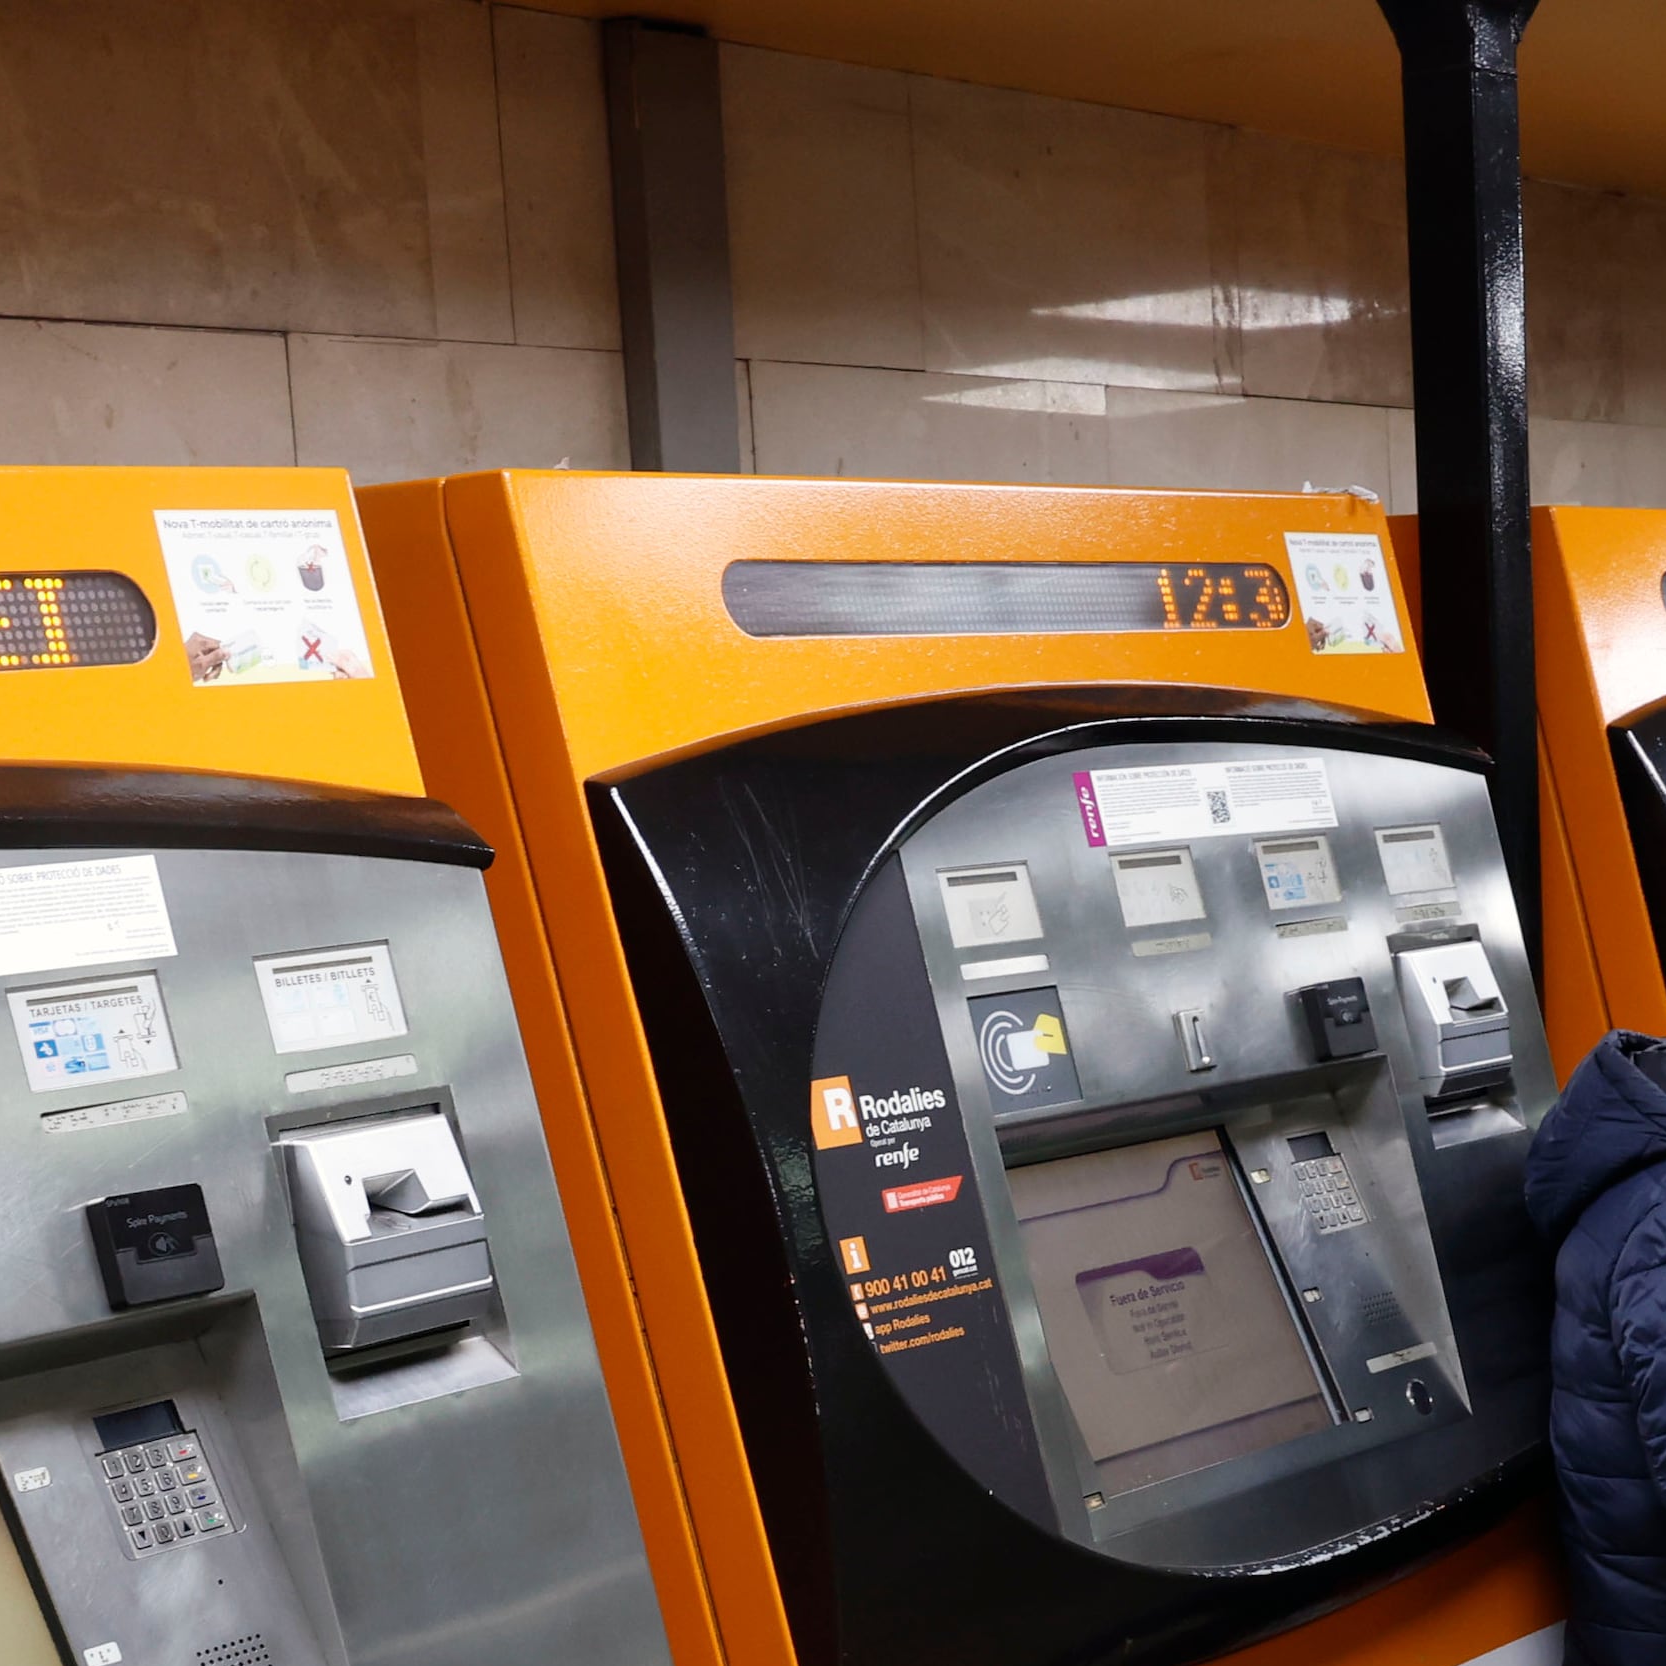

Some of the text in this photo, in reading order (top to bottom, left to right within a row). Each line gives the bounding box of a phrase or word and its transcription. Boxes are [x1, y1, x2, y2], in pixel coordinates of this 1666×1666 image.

[163, 518, 189, 529] Nova
[190, 518, 245, 529] T-mobilitat
[247, 519, 258, 529] de
[260, 517, 290, 529] cartró
[1080, 786, 1100, 838] renfe
[7, 872, 34, 885] SOBRE
[36, 867, 81, 881] PROTECCIÓ
[82, 866, 94, 877] DE
[95, 864, 123, 876] DADES
[274, 972, 323, 988] BILLETES
[330, 966, 376, 981] BITLLETS
[29, 1003, 82, 1018] TARJETAS
[90, 994, 144, 1010] TARGETES
[823, 1087, 858, 1131] R
[859, 1086, 946, 1120] Rodalies
[865, 1115, 933, 1138] de Catalunya
[874, 1141, 920, 1170] renfe
[948, 1246, 976, 1268] 012
[864, 1278, 891, 1298] 900
[892, 1273, 909, 1291] 41
[911, 1269, 929, 1288] 00
[930, 1265, 947, 1283] 41
[1110, 1281, 1185, 1306] Fuera de Servicio
[870, 1277, 993, 1315] www.rodaliesdecatalunya.cat
[874, 1313, 931, 1336] app Rodalies
[879, 1326, 965, 1355] twitter.com/rodalies
[154, 1449, 163, 1462] 3
[140, 1478, 153, 1492] 5
[163, 1472, 173, 1486] 6
